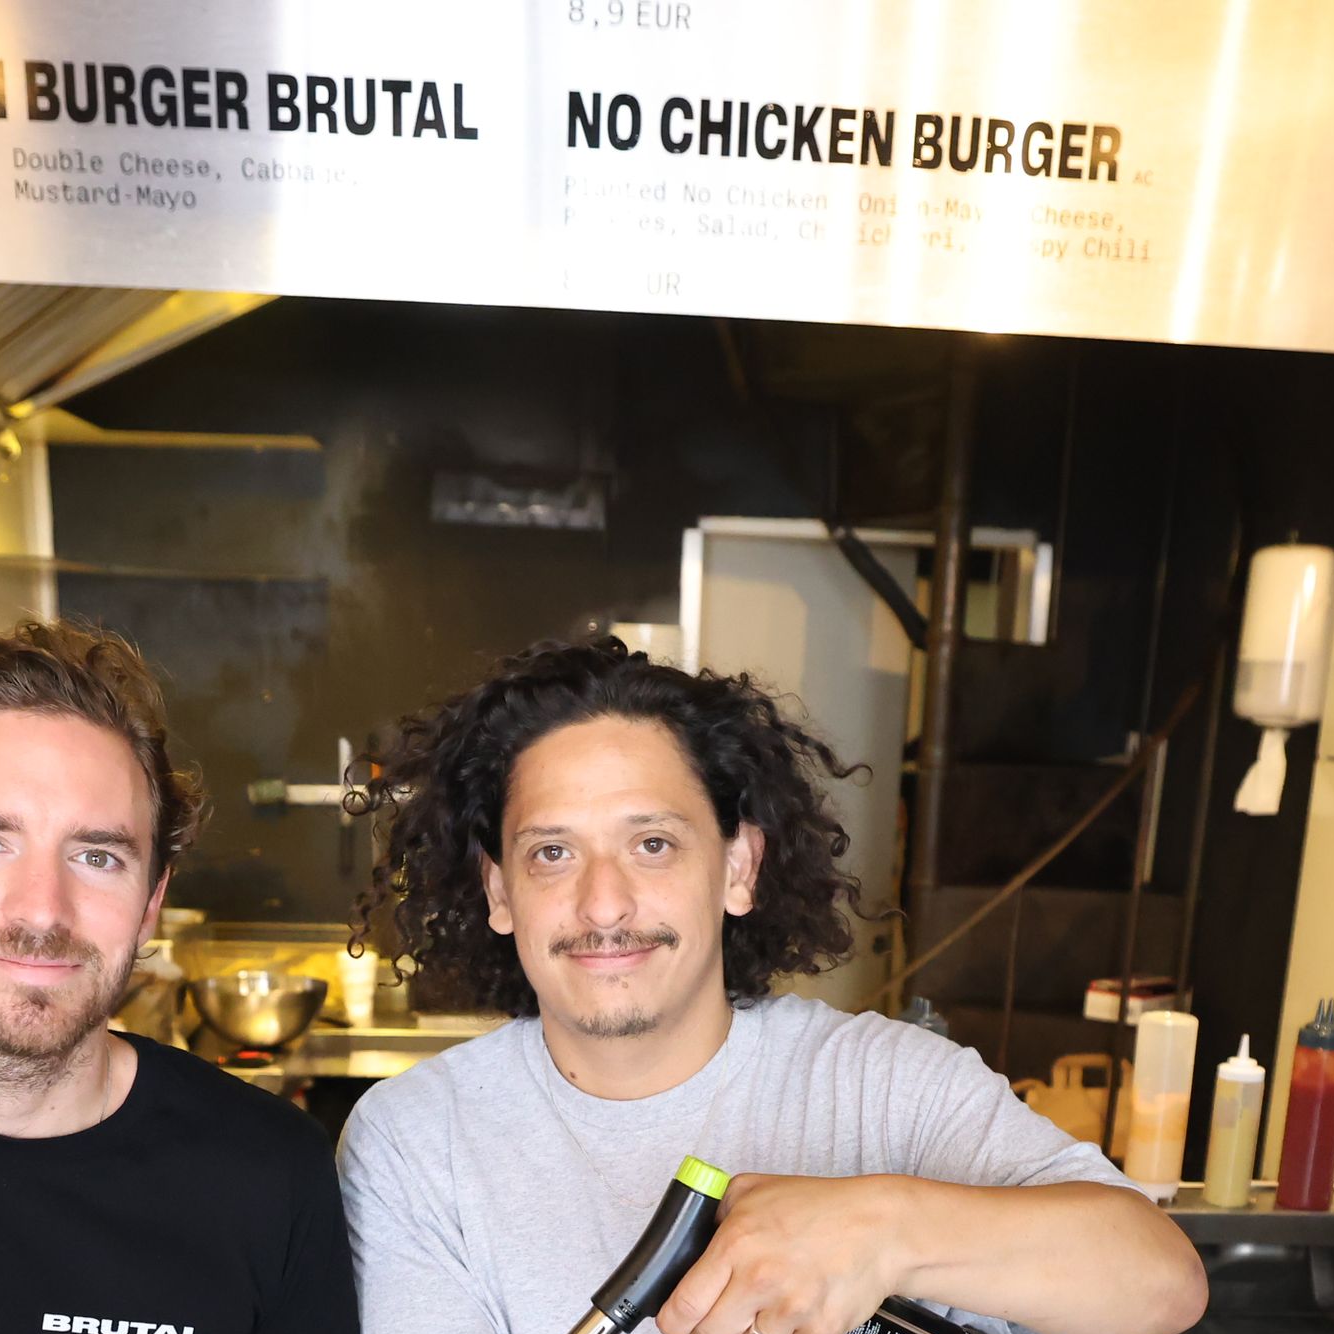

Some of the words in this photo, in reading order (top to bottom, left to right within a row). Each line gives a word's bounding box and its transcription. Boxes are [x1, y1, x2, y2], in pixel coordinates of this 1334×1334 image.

[636, 0, 691, 31] EUR
[24, 60, 250, 130] BURGER
[267, 73, 479, 140] BRUTAL
[567, 91, 643, 151] NO
[660, 97, 895, 168] CHICKEN
[913, 114, 1122, 183] BURGER
[13, 147, 104, 176] Double
[119, 152, 224, 182] Cheese,
[14, 179, 197, 211] Mustard-Mayo
[683, 179, 712, 204] No
[1082, 236, 1151, 262] Chili
